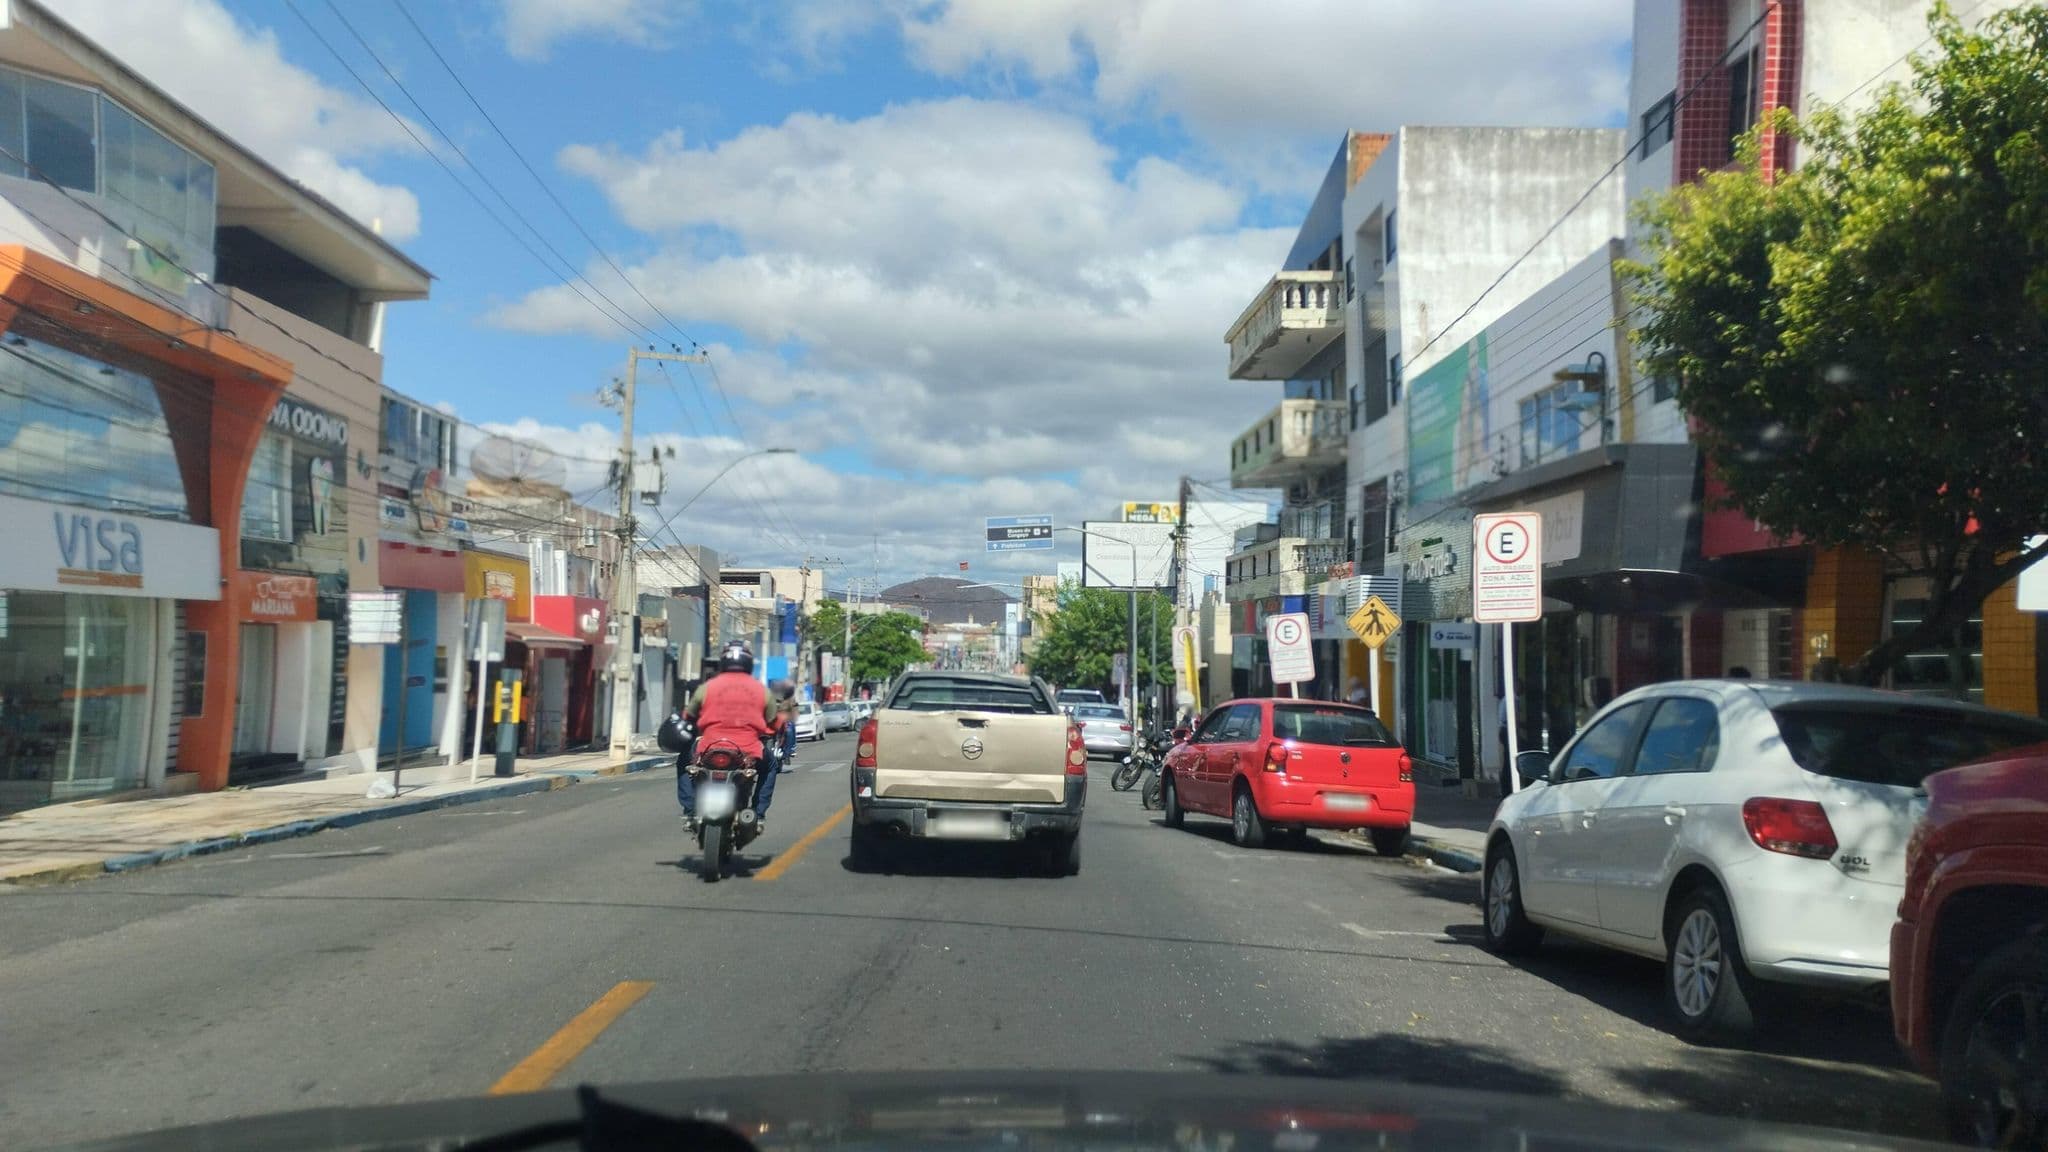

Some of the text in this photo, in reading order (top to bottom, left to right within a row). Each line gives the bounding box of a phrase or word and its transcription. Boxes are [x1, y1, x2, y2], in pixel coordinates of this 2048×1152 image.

[1500, 532, 1513, 553] E
[1284, 625, 1293, 639] E
[1840, 855, 1871, 866] GOL
